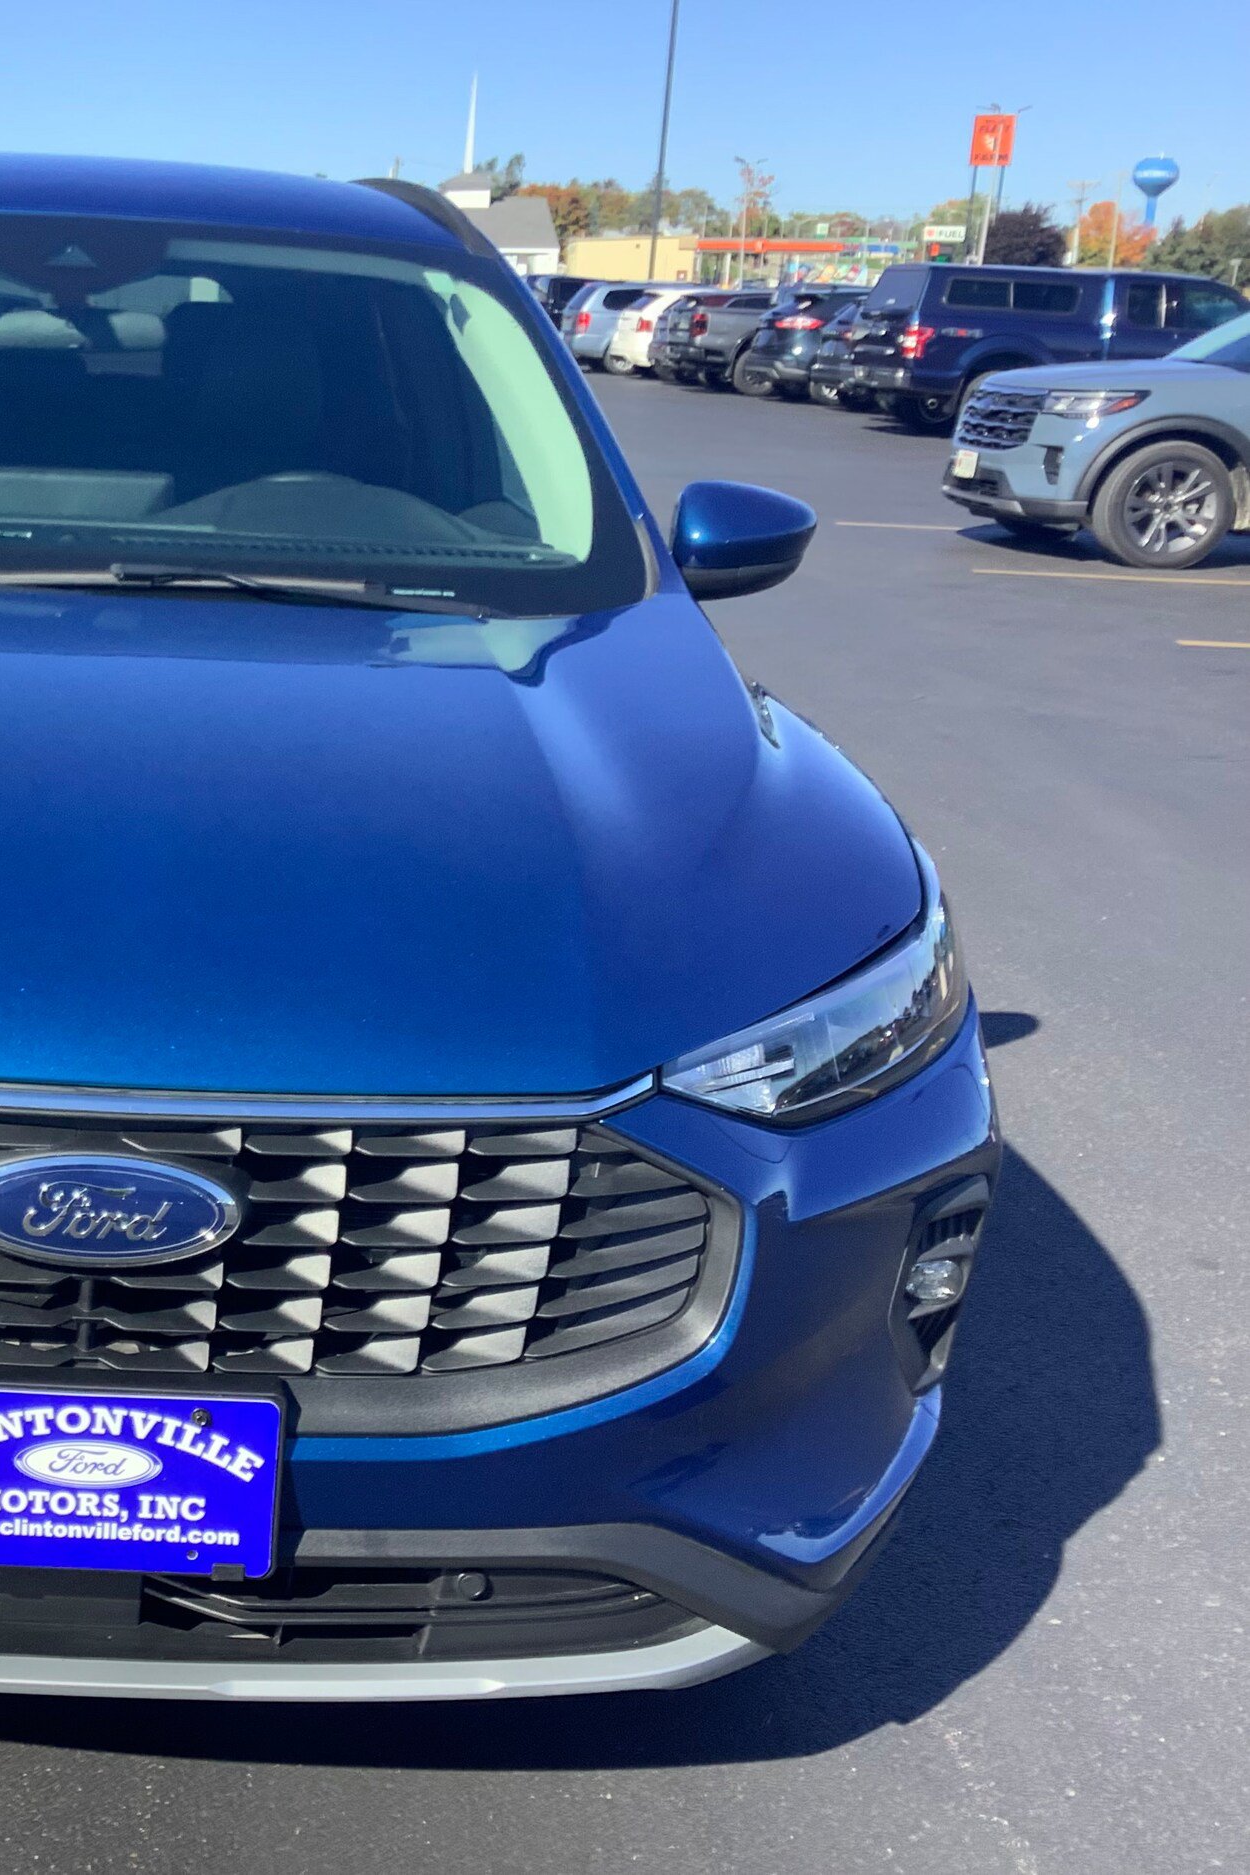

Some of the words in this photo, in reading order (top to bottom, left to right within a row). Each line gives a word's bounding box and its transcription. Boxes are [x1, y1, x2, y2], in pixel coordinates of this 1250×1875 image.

[938, 229, 964, 239] FUEL
[23, 1180, 173, 1242] Ford
[48, 1448, 128, 1476] Ford
[137, 1495, 206, 1521] INC
